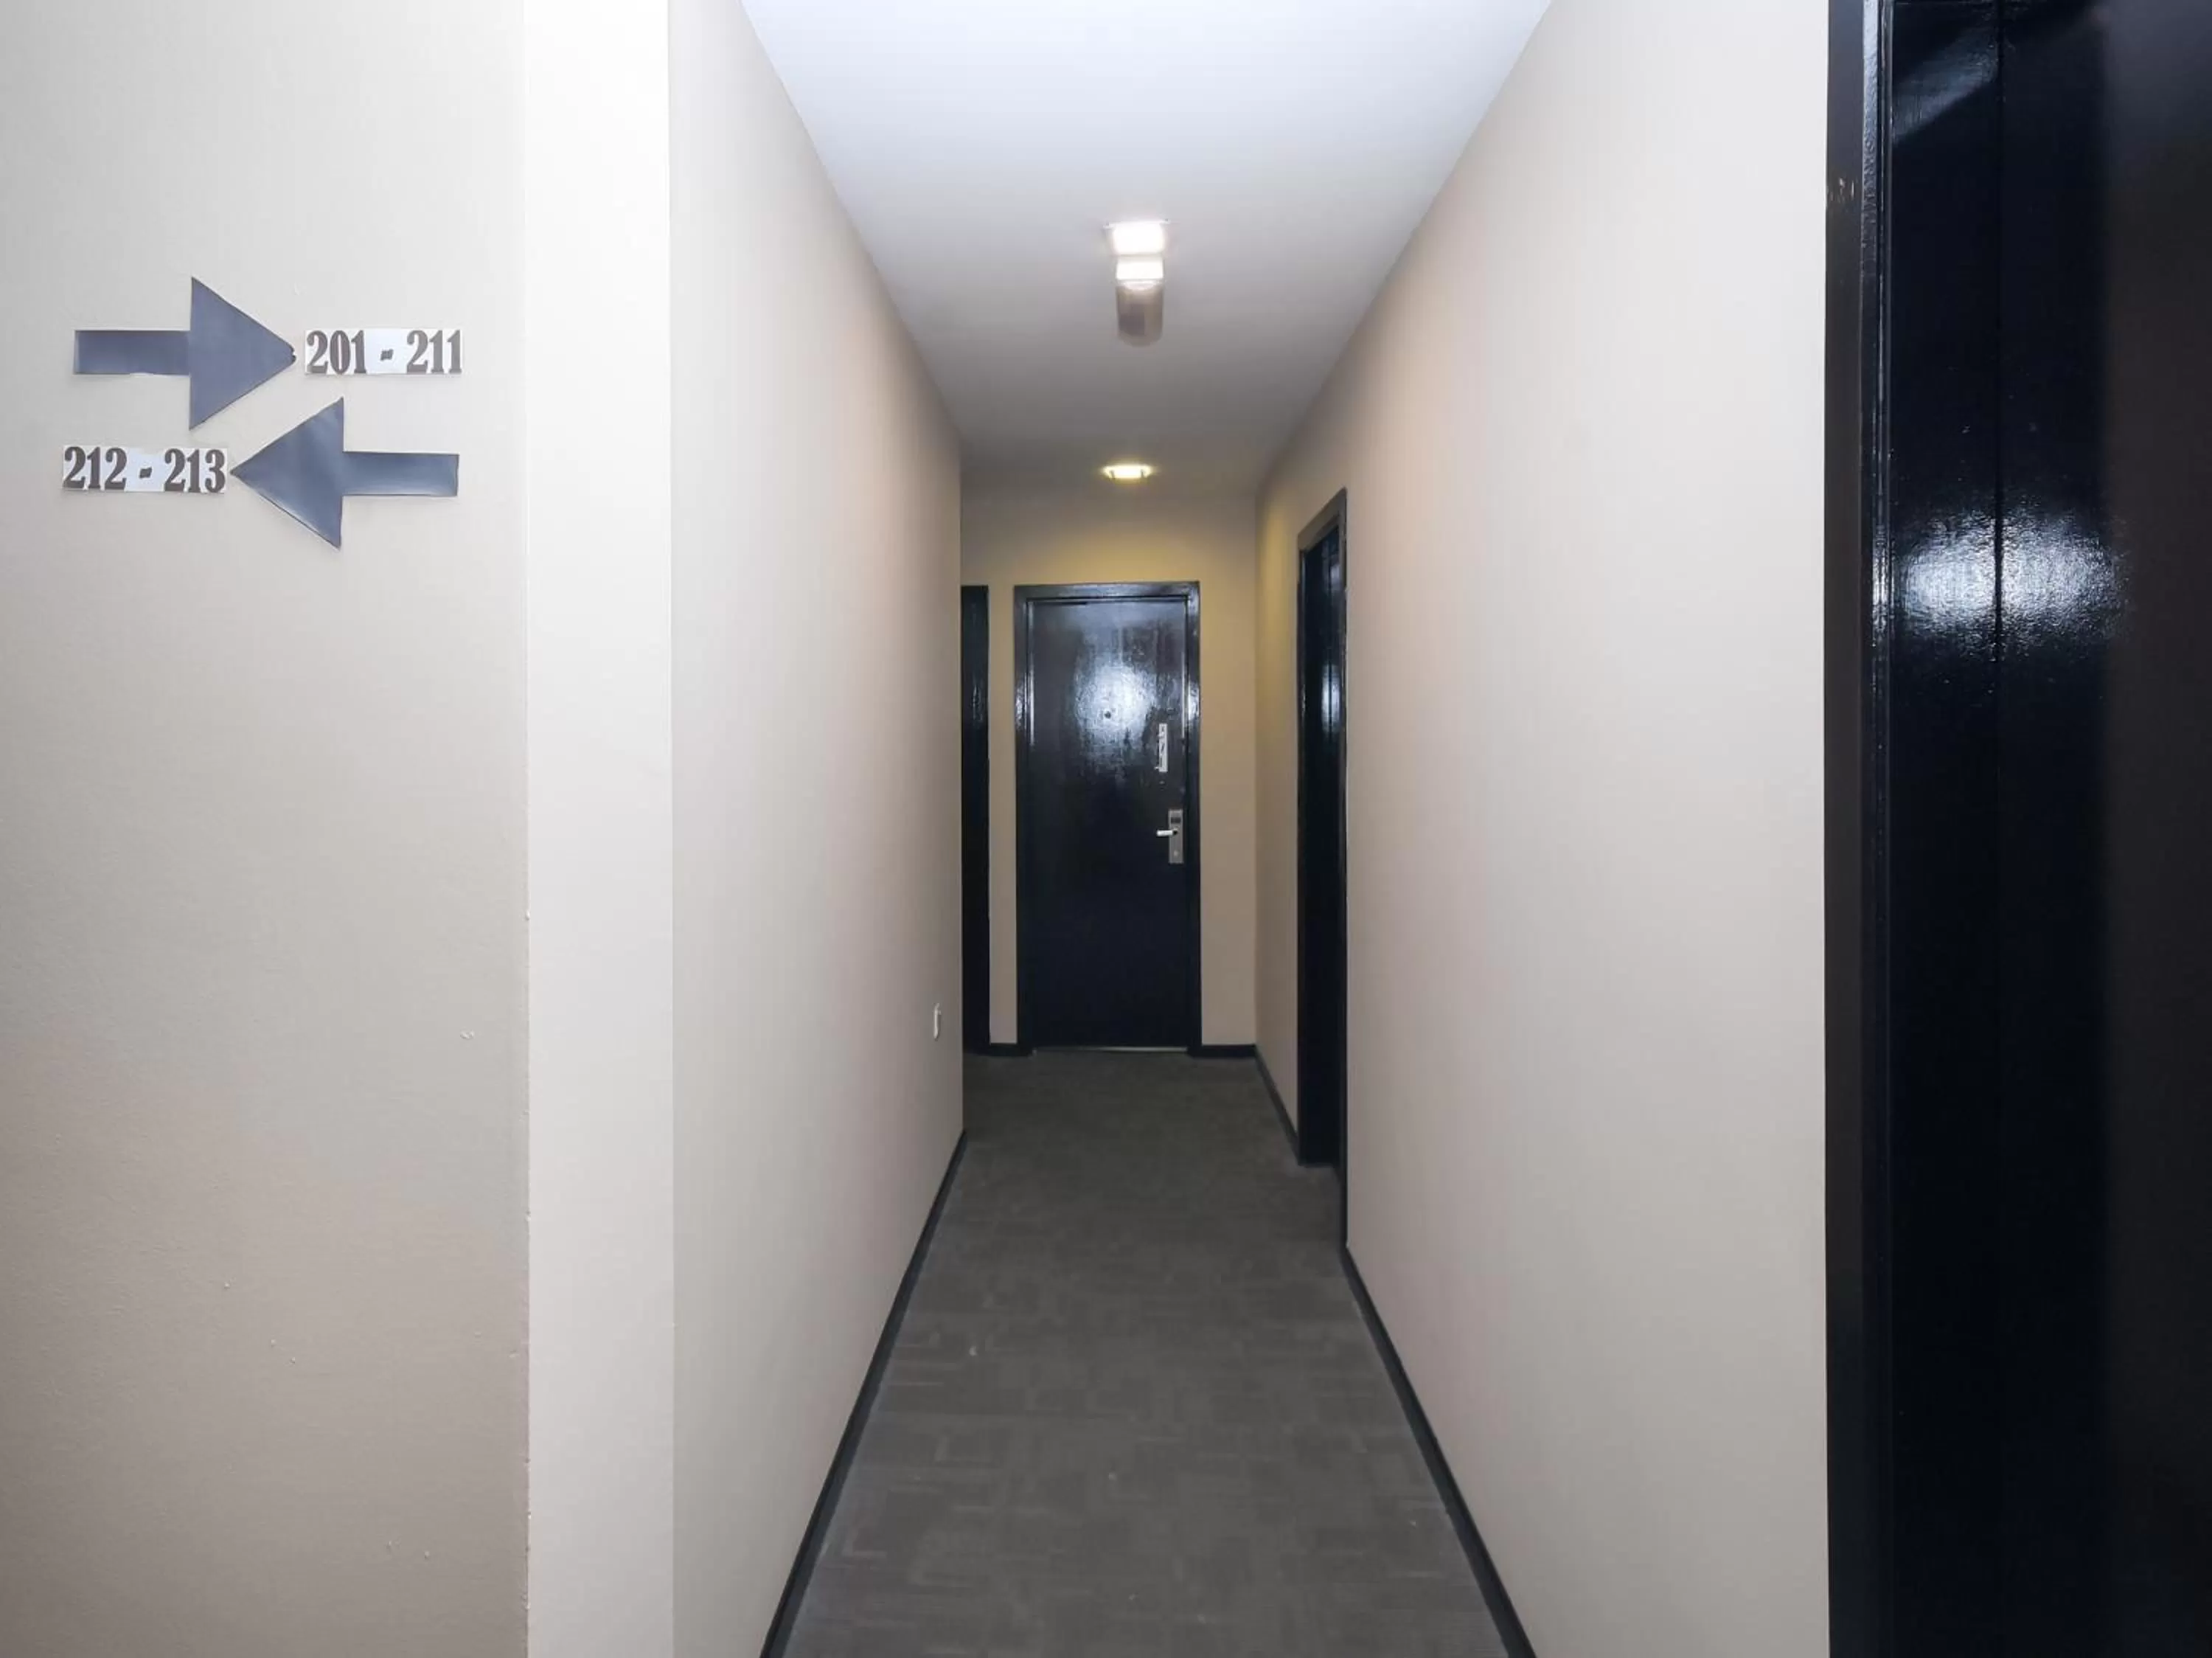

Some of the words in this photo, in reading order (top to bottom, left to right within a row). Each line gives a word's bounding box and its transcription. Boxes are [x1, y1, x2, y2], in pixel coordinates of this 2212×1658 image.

[306, 330, 366, 375] 201
[406, 330, 462, 374] 211
[63, 446, 127, 490] 212
[164, 448, 226, 493] 213
